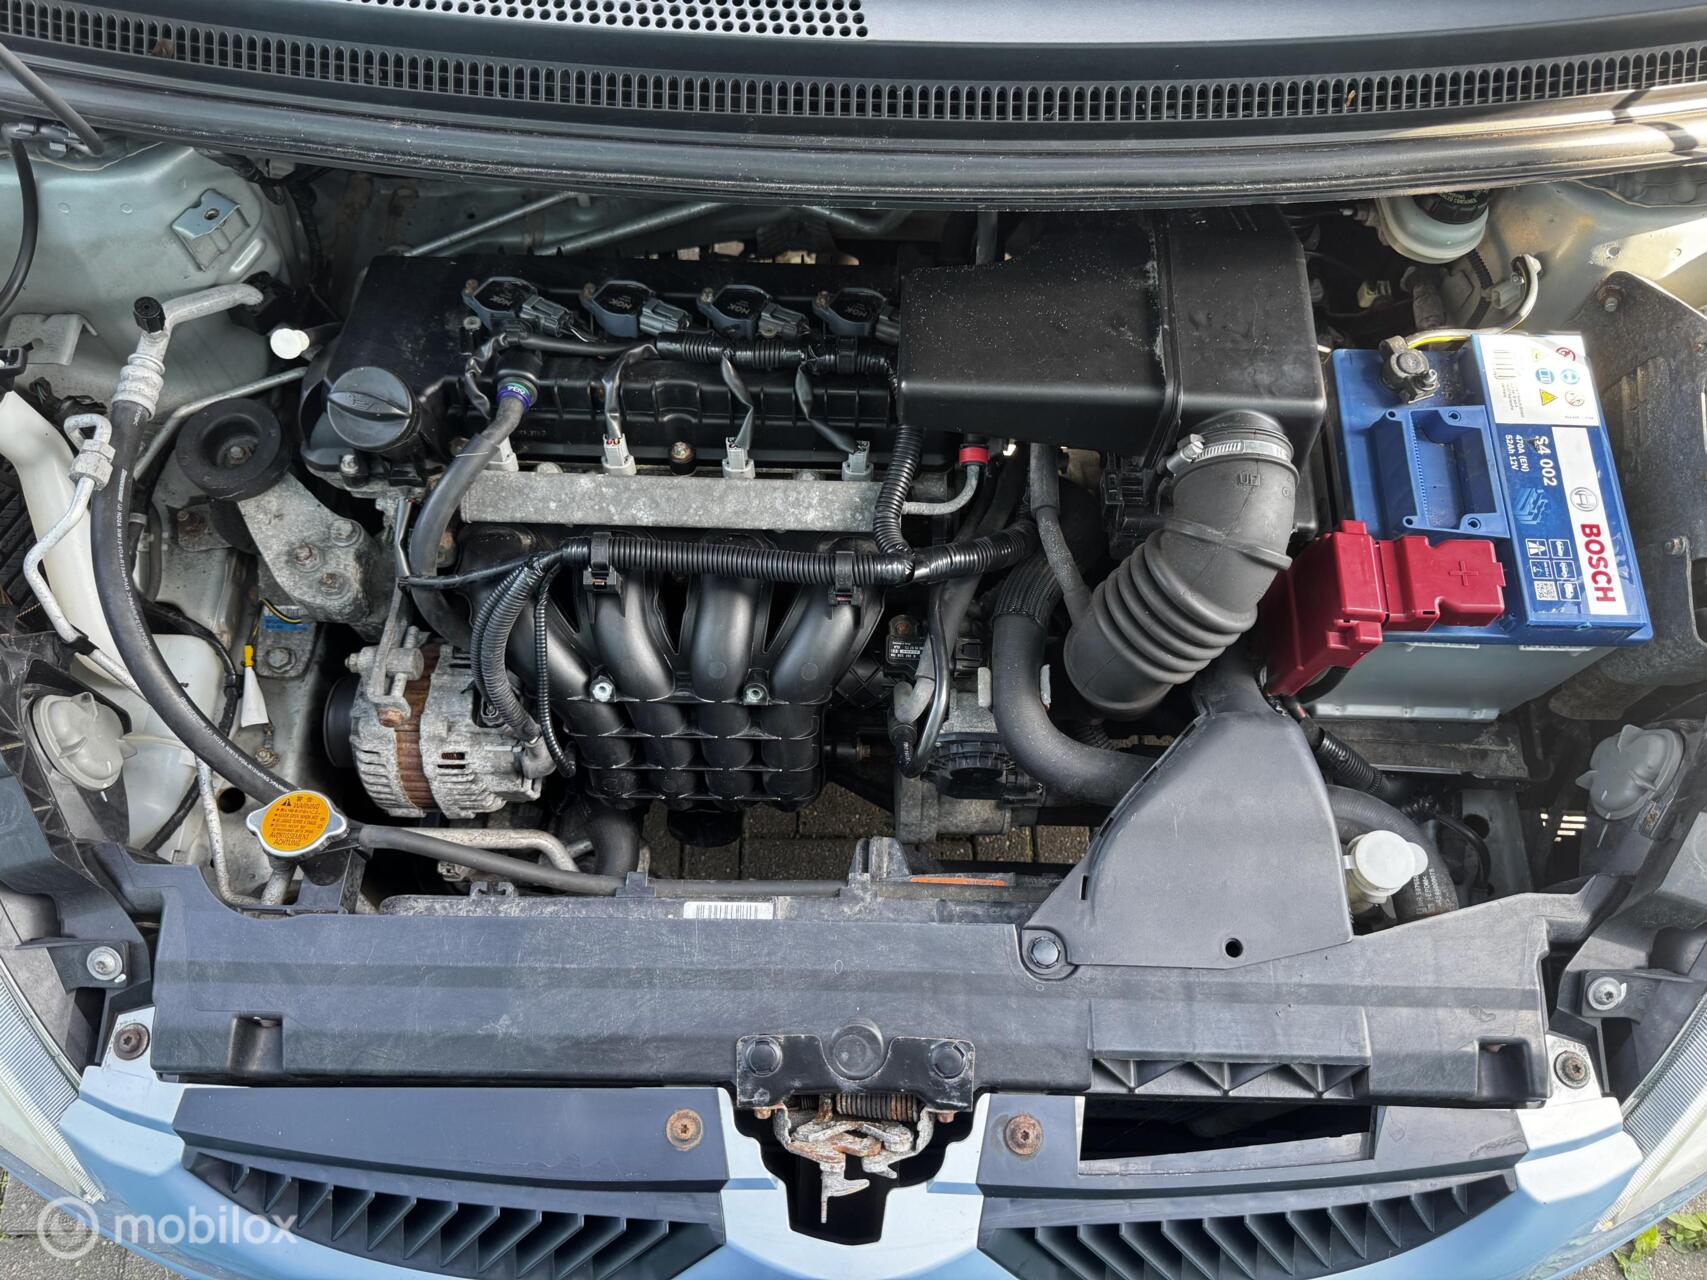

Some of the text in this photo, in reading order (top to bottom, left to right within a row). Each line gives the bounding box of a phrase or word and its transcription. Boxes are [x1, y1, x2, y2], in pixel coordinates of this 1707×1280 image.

[489, 295, 513, 306] NGK
[608, 298, 633, 309] NGK
[727, 303, 751, 314] NGK
[1505, 434, 1520, 471] 52Ah 12V
[1515, 434, 1530, 472] 470A (EN)
[1535, 435, 1558, 487] S4 002
[1580, 523, 1616, 602] BOSCH
[273, 839, 301, 847] ACHTUNG
